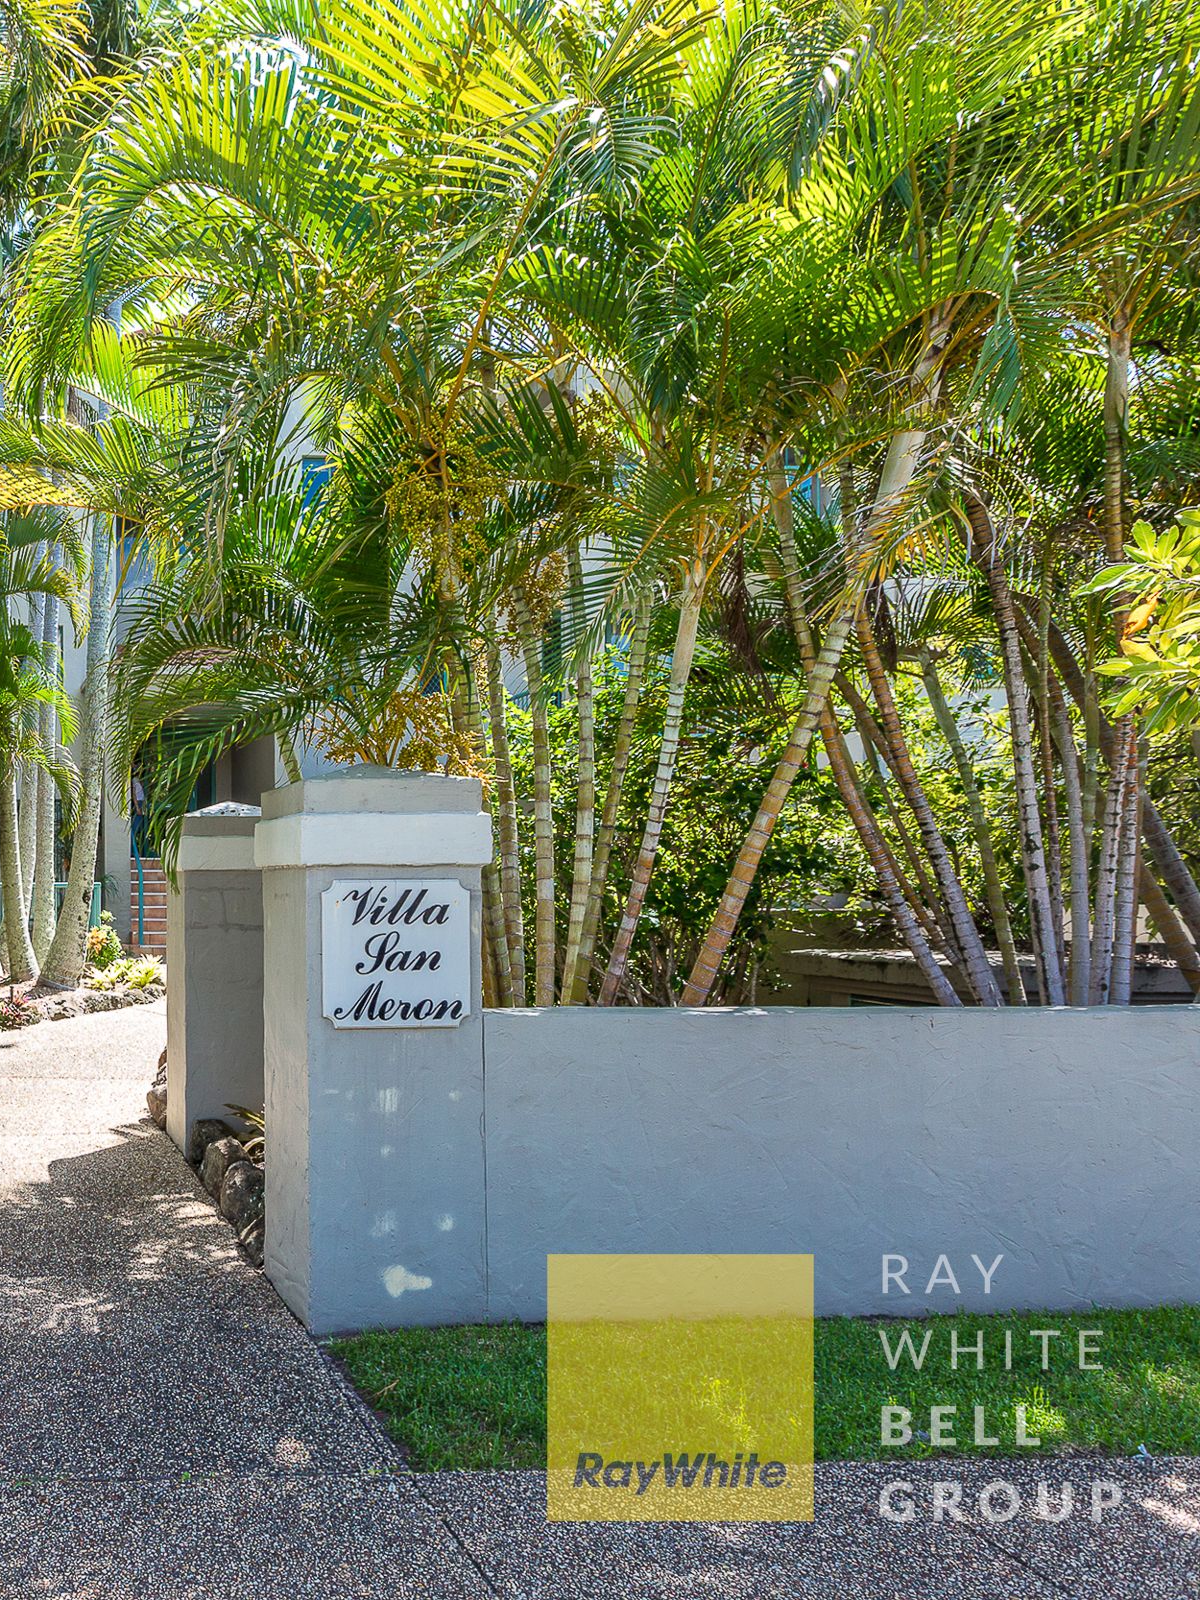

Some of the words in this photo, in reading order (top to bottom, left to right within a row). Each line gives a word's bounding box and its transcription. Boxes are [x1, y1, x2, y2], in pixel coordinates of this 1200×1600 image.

[342, 886, 450, 926] Villa
[355, 931, 441, 975] San
[333, 980, 463, 1021] Meron
